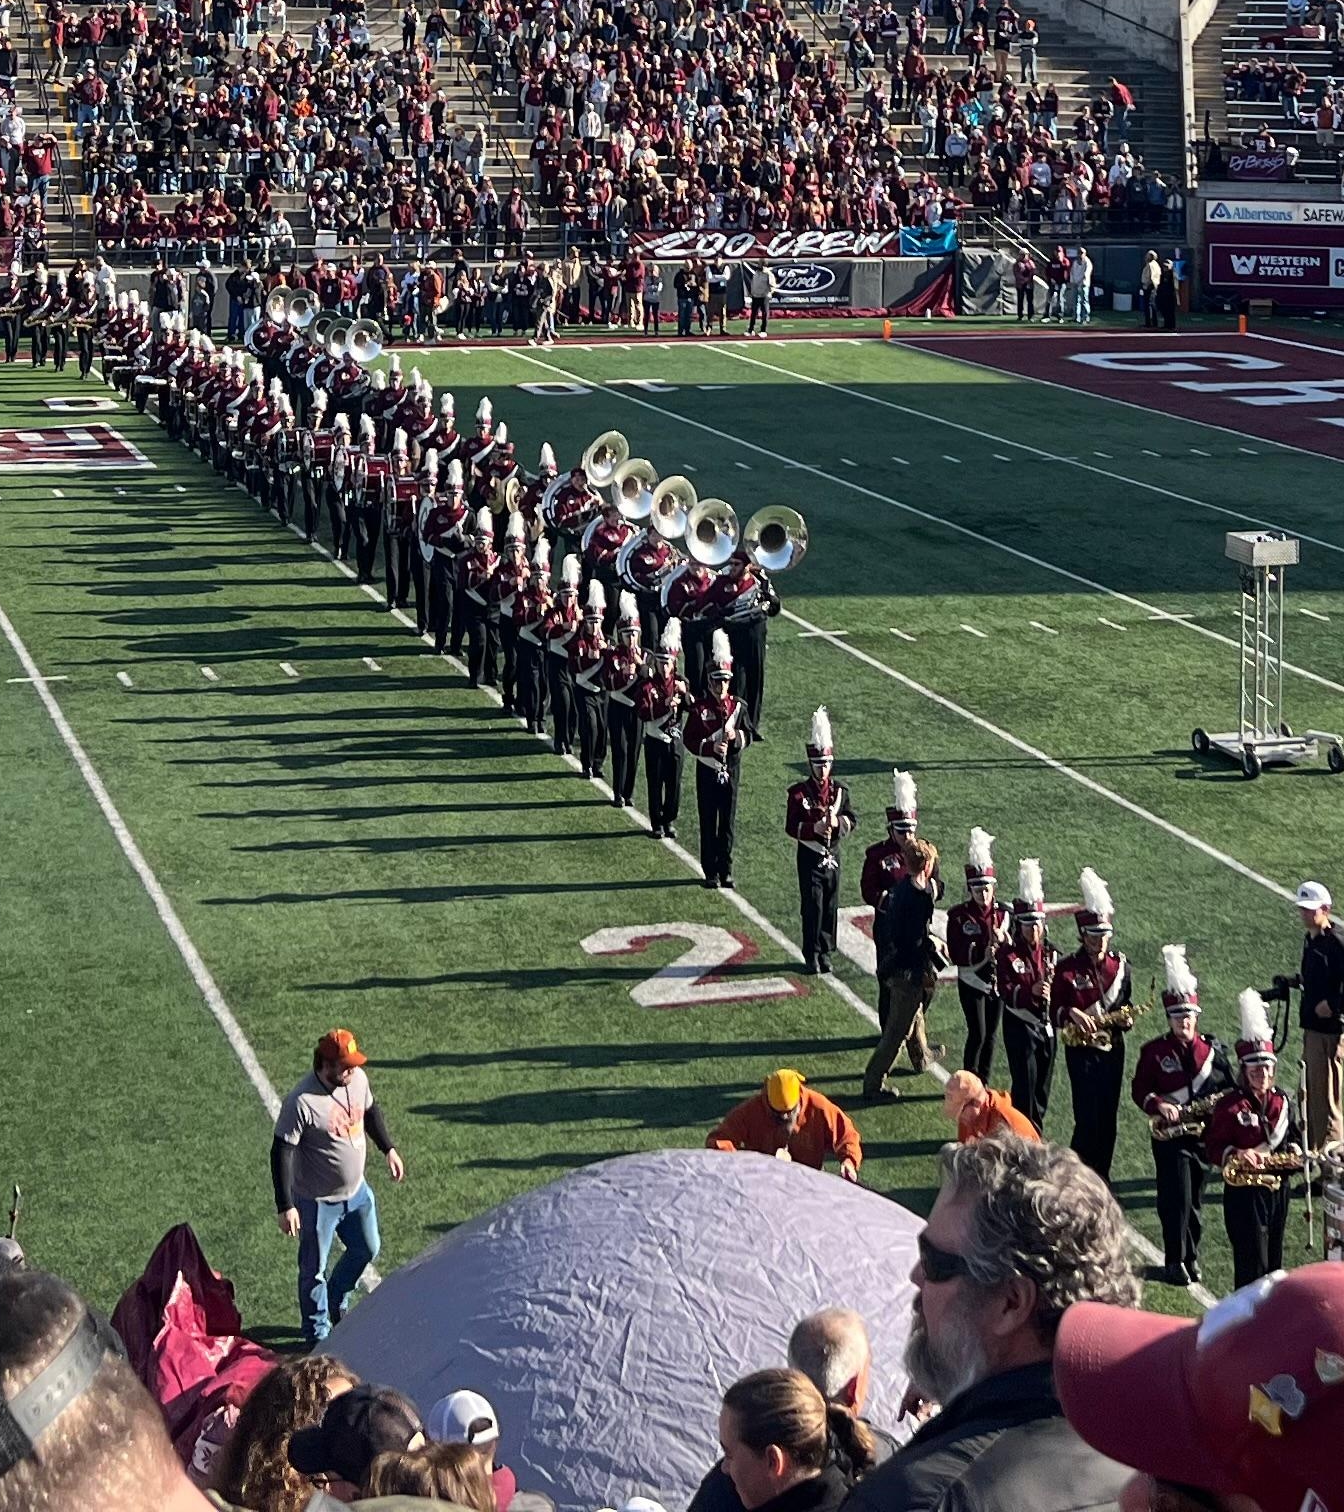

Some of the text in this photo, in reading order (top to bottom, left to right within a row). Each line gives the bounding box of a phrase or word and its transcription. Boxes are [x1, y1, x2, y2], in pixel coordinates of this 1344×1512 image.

[1233, 207, 1293, 221] Albertsons
[654, 229, 899, 257] ZOO CREW
[1258, 255, 1321, 266] WESTERN
[777, 267, 820, 289] Ford
[1258, 266, 1304, 277] STATES
